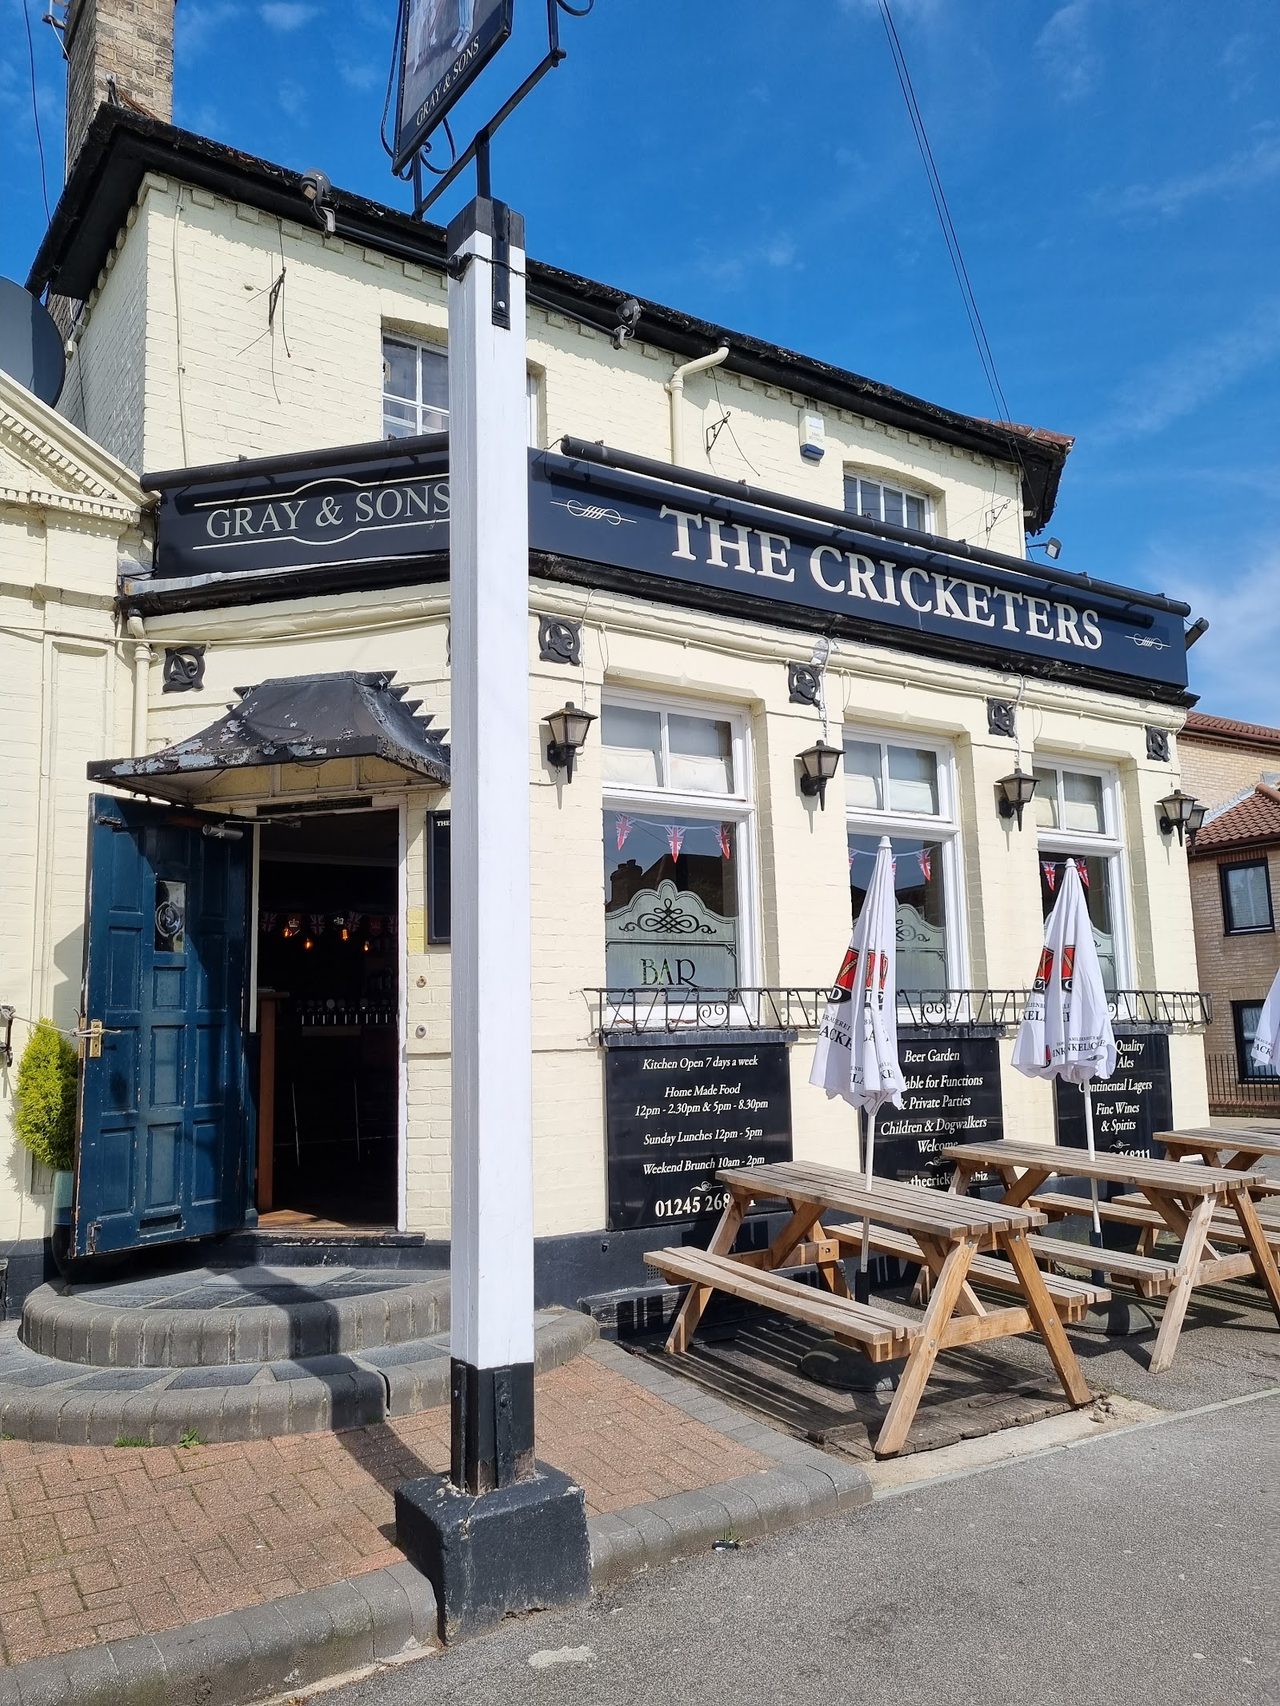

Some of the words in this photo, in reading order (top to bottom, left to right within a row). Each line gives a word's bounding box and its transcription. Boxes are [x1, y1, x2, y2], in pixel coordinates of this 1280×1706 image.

[416, 83, 442, 126] GRAY
[443, 75, 450, 93] &
[453, 35, 480, 80] SONS
[206, 498, 306, 540] GRAY
[315, 496, 345, 528] &
[355, 482, 450, 525] SONS
[659, 504, 796, 582] THE
[809, 544, 1103, 649] CRICKETERS
[641, 958, 698, 987] BAR
[904, 1049, 926, 1063] Beer
[927, 1048, 960, 1062] Garden
[1115, 1039, 1145, 1055] Quality
[642, 1057, 678, 1070] Kitchen
[679, 1057, 704, 1072] Open
[705, 1057, 712, 1069] 7
[712, 1055, 731, 1070] days
[738, 1055, 758, 1066] week
[1117, 1056, 1135, 1069] Ales
[925, 1074, 939, 1089] for
[940, 1074, 983, 1088] Functions
[1128, 1078, 1153, 1094] Lagers
[664, 1086, 692, 1098] Home
[693, 1084, 718, 1096] Made
[718, 1083, 741, 1095] Food
[635, 1105, 661, 1119] 12pm
[667, 1103, 701, 1116] 2.30pm
[702, 1102, 712, 1112] &
[713, 1102, 732, 1115] 5pm
[738, 1099, 769, 1112] 8.30pm
[909, 1096, 941, 1110] Private
[941, 1094, 971, 1108] Parties
[1096, 1102, 1114, 1116] Fine
[1114, 1101, 1140, 1114] Wines
[880, 1120, 923, 1135] Children
[924, 1119, 934, 1132] &
[935, 1115, 988, 1134] Dogwalkers
[1100, 1120, 1109, 1132] &
[1110, 1119, 1137, 1135] Spirits
[643, 1133, 676, 1146] Sunday
[677, 1130, 713, 1143] Lunches
[714, 1129, 738, 1143] 12pm
[745, 1127, 763, 1140] 5pm
[643, 1161, 683, 1175] Weekend
[684, 1158, 716, 1171] Brunch
[718, 1157, 740, 1168] 10am
[746, 1155, 765, 1167] 2pm
[655, 1196, 701, 1217] 01245
